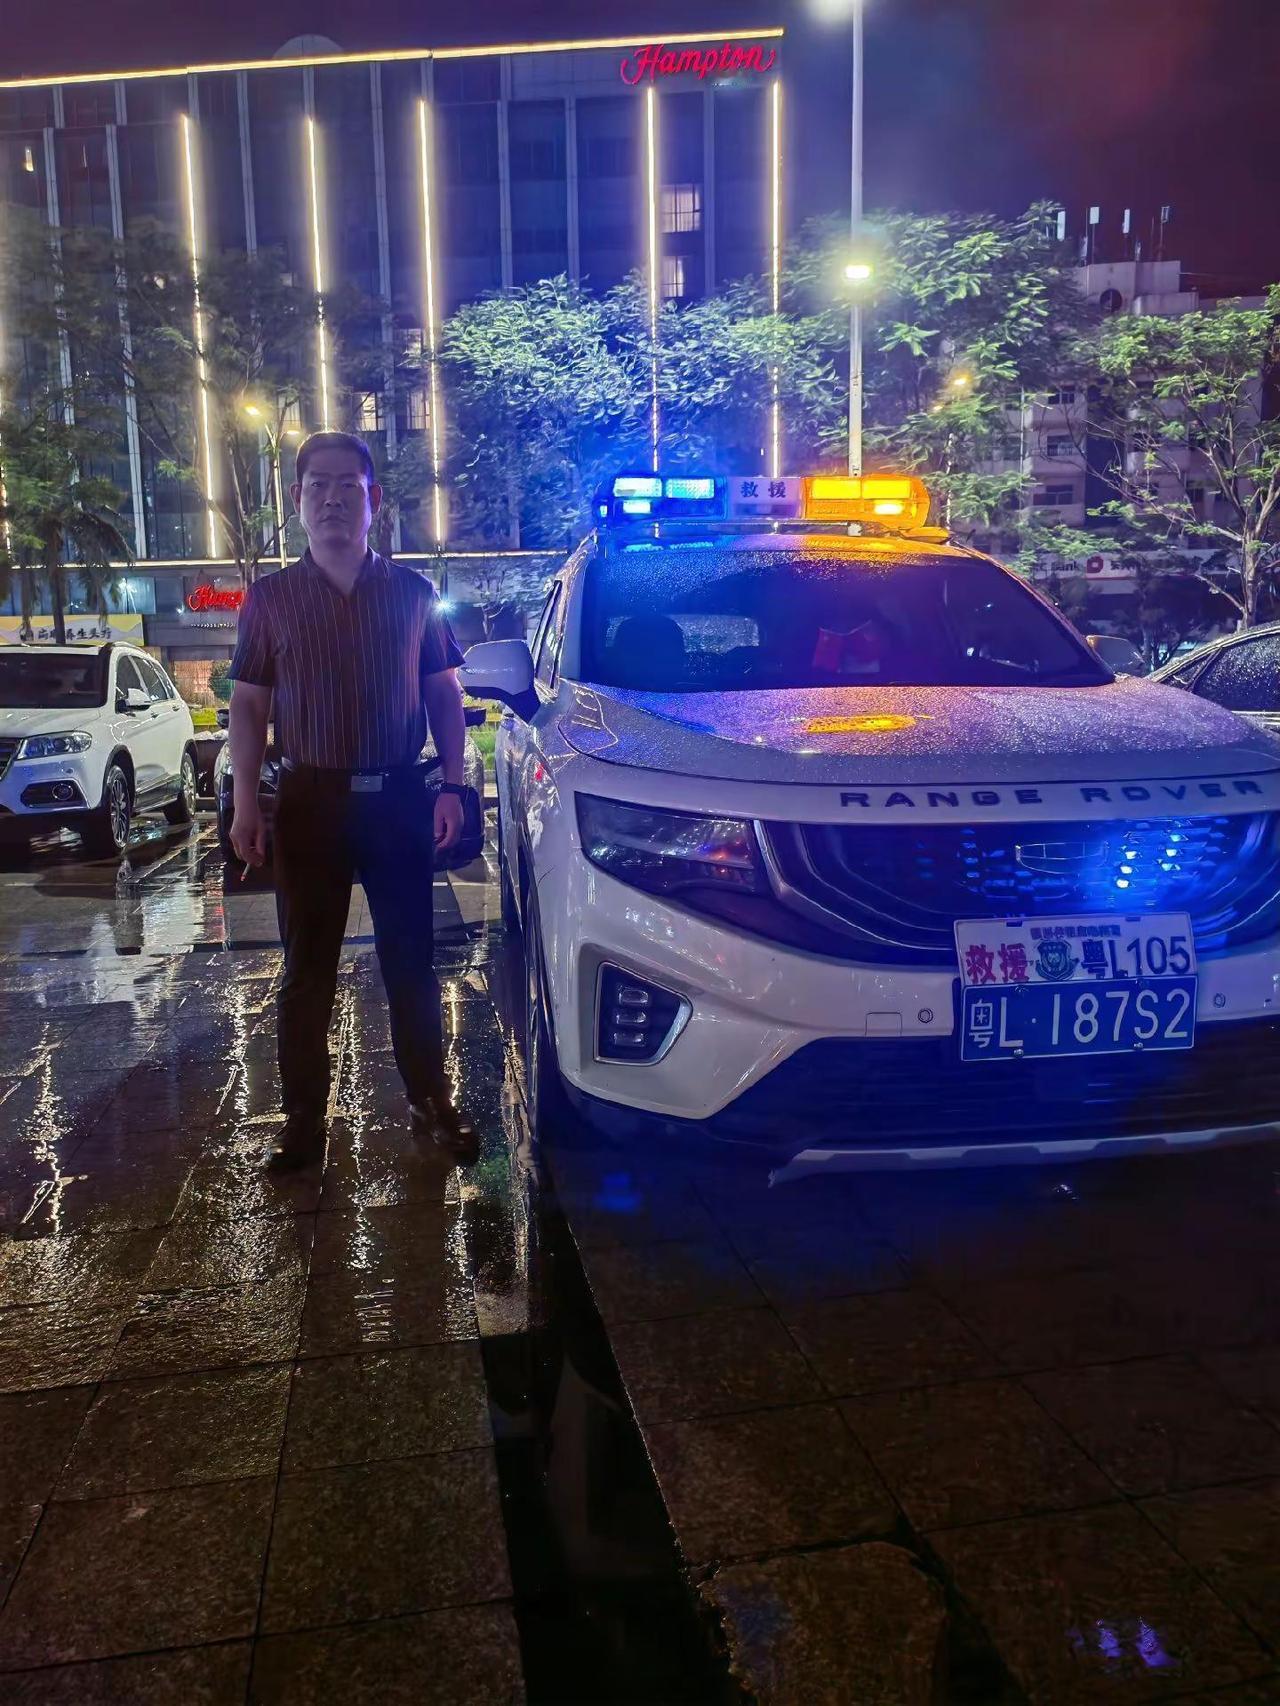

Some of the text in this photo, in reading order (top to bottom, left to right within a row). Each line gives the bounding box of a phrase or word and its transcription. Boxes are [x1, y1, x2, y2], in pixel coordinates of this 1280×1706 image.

[620, 42, 776, 85] Hampton
[741, 481, 787, 498] 救援
[840, 780, 1264, 809] RANGE ROVER
[965, 936, 1191, 984] 救援 粤L105
